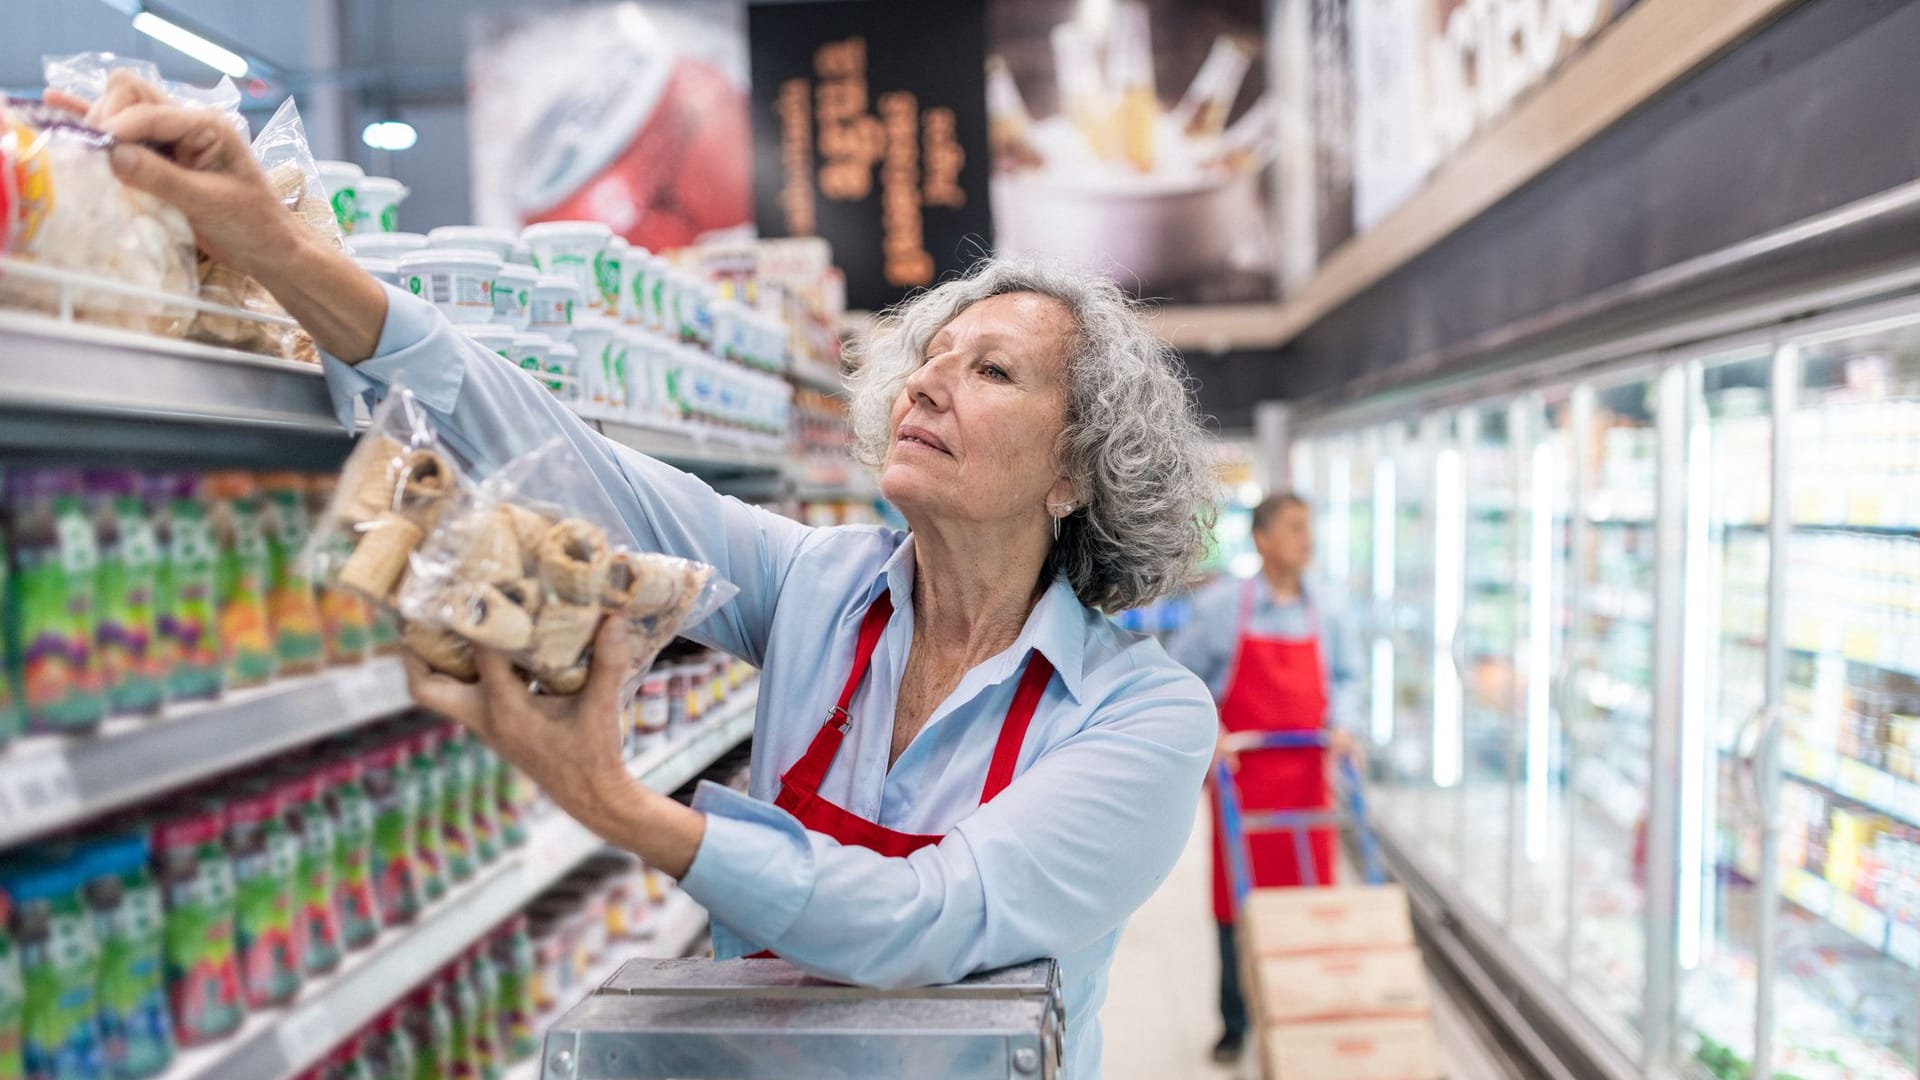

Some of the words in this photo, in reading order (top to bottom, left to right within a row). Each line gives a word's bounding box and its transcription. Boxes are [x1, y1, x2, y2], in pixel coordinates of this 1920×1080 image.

[814, 37, 885, 198] agua
[880, 94, 932, 283] gaseosas
[923, 110, 965, 206] jugos
